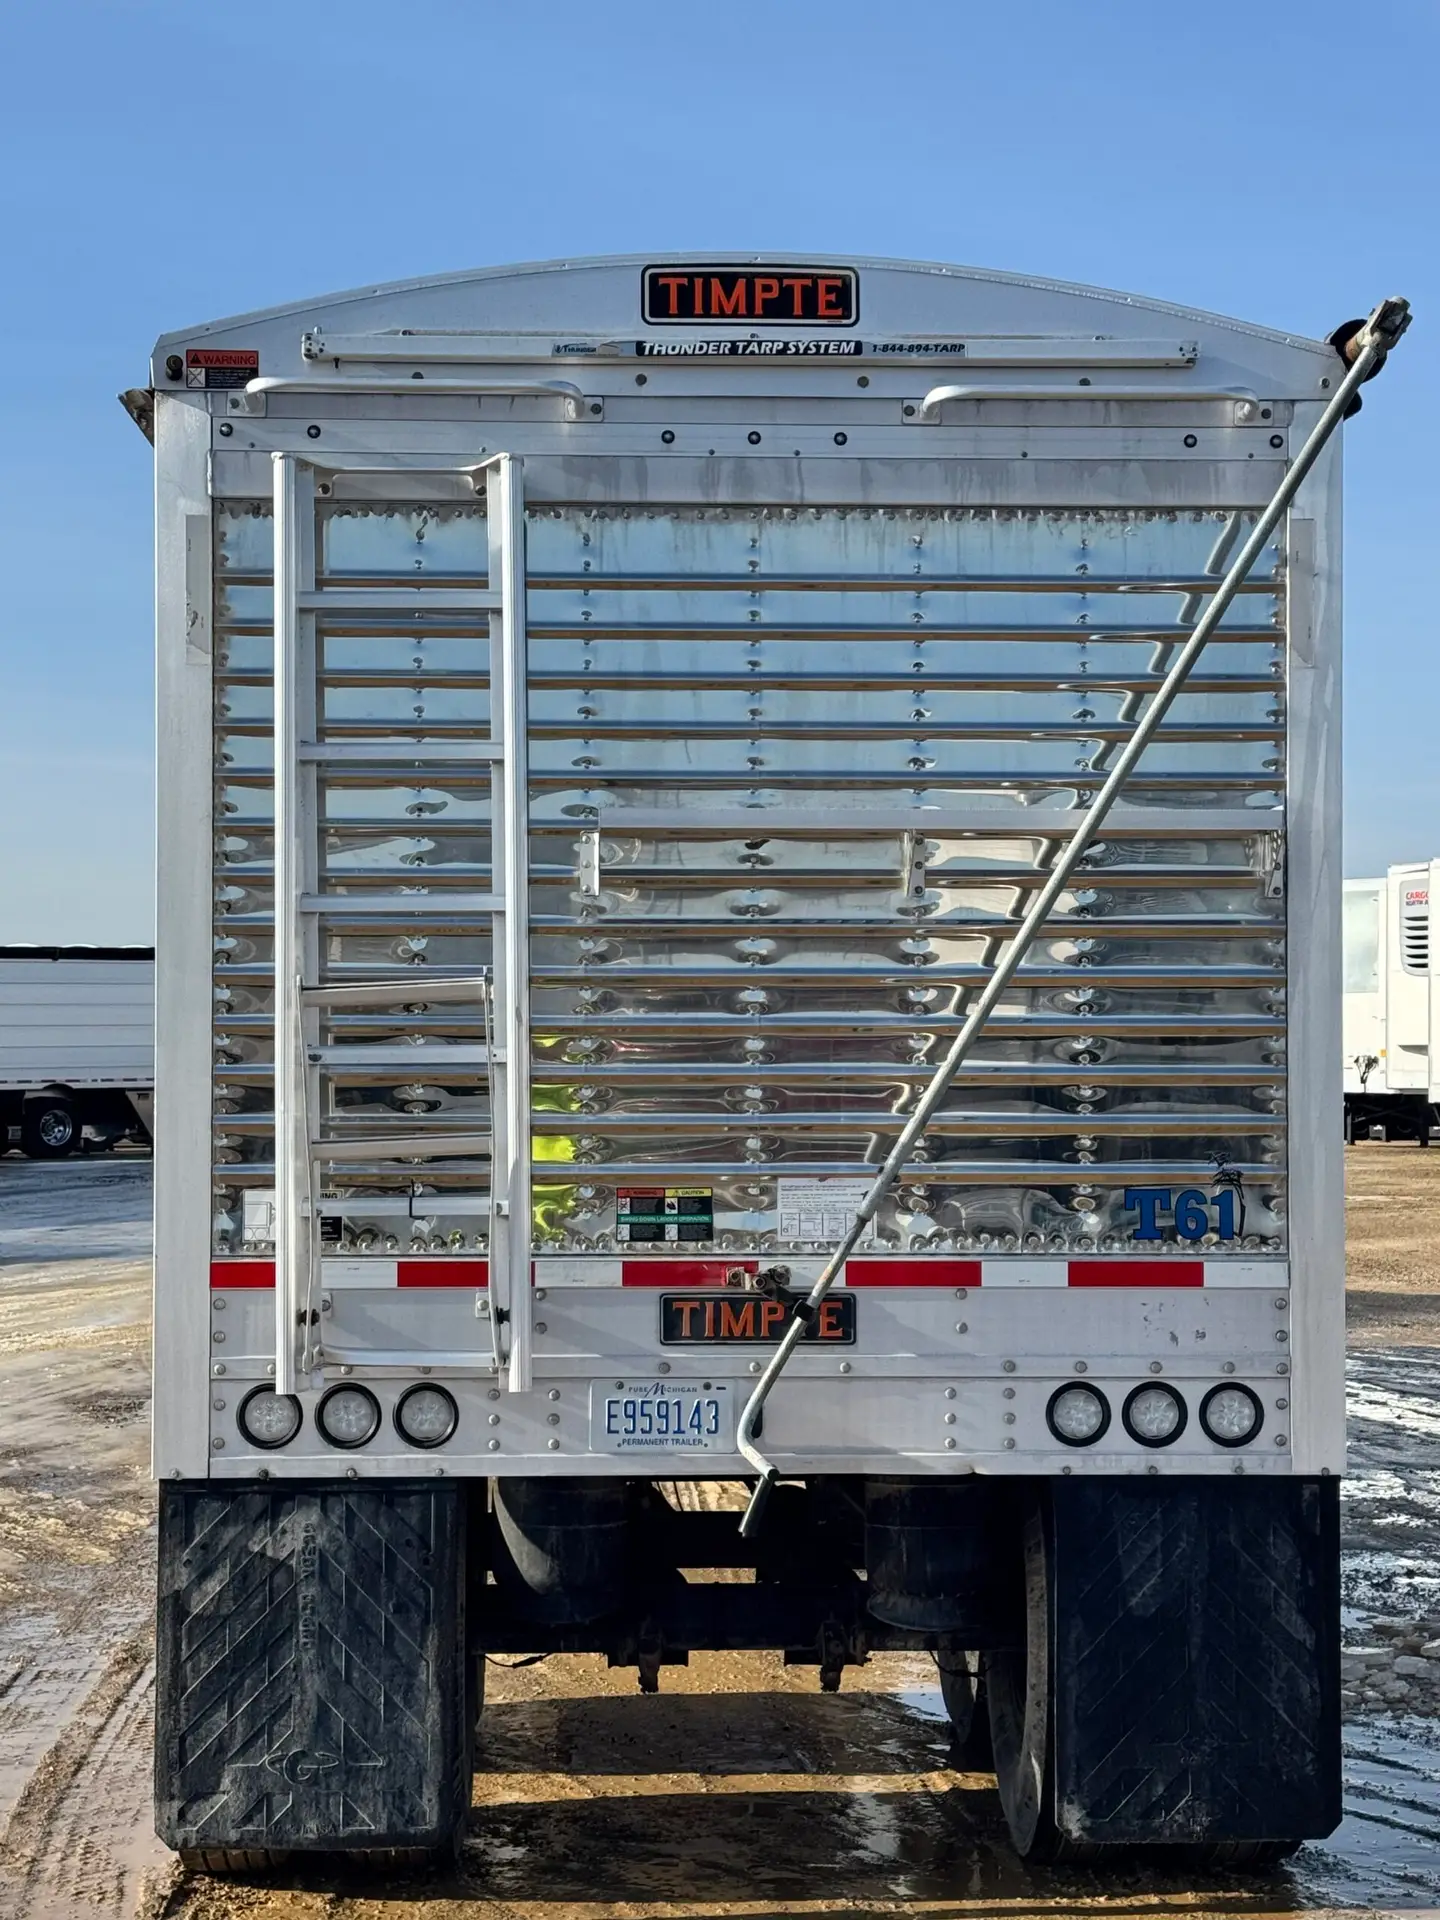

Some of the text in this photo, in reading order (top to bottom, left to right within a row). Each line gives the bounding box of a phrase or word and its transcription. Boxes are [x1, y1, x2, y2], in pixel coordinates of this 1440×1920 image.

[658, 277, 843, 316] TIMPTE
[643, 341, 855, 355] THUNDER TARP SYSTEM
[872, 343, 966, 353] 1-844-894-TARP
[203, 355, 256, 365] WARNING
[1124, 1188, 1235, 1241] T61
[672, 1301, 844, 1337] TIMPE
[644, 1381, 698, 1398] MICHIGAN
[606, 1399, 720, 1435] E959143
[622, 1438, 704, 1446] PERMANENT TRAILER
